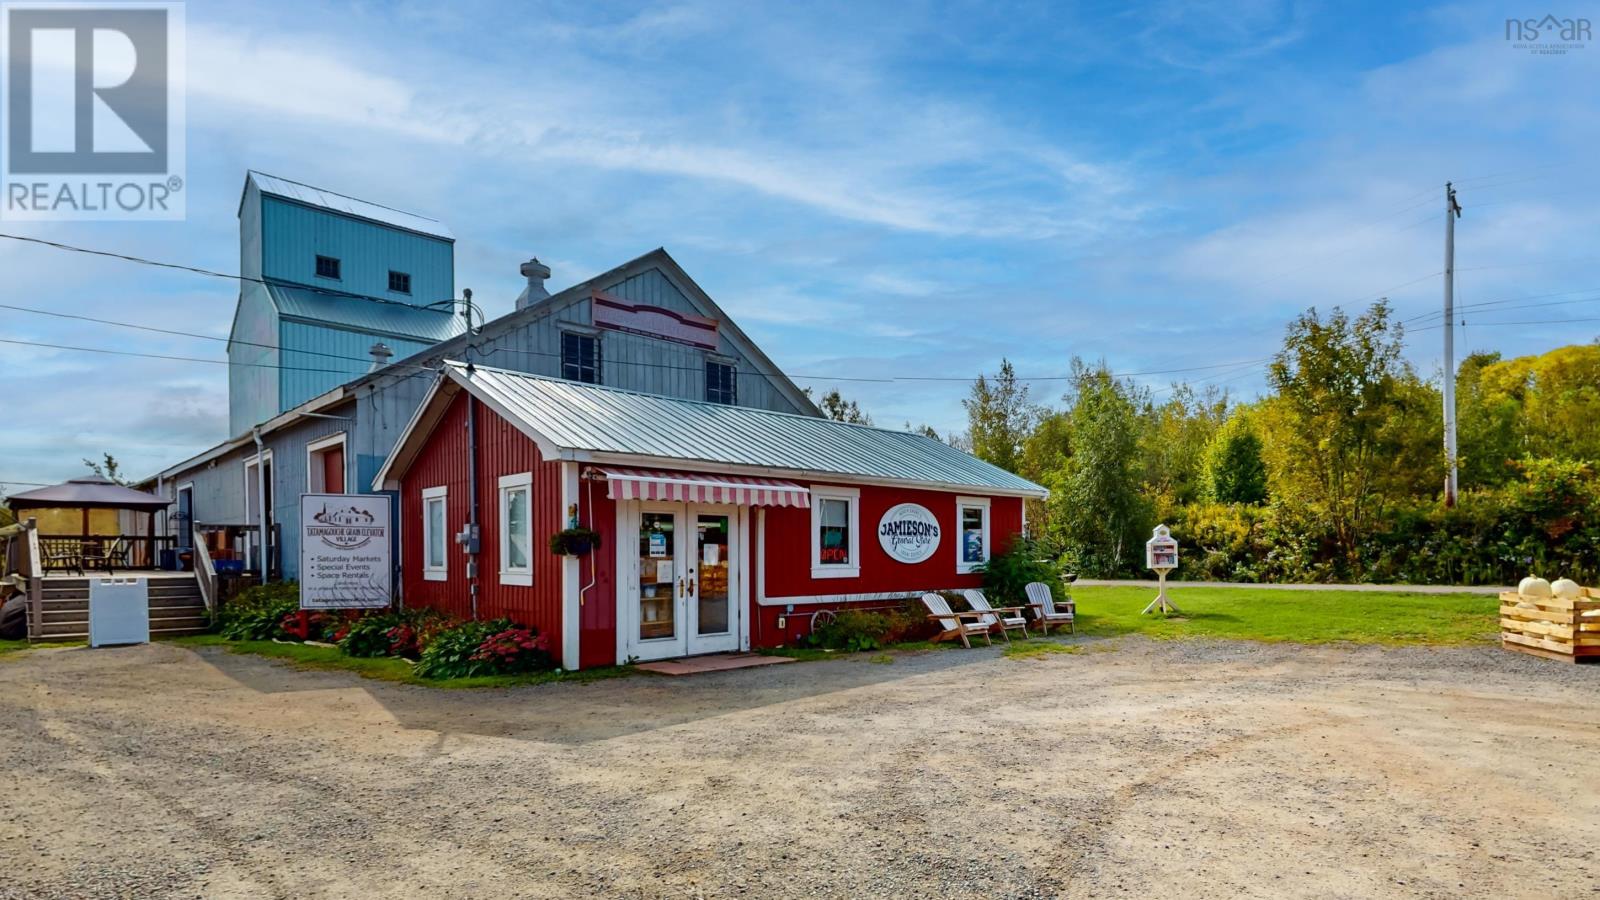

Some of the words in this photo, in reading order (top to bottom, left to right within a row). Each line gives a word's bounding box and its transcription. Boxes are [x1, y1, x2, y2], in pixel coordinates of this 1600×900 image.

[307, 528, 345, 537] TATAMAGOUCHE
[346, 528, 361, 536] GRAIN
[362, 528, 385, 537] ELEVATOR
[880, 520, 939, 538] JAMIESON'S
[891, 535, 914, 552] General
[317, 555, 350, 563] Saturday
[317, 563, 344, 571] Special
[317, 572, 340, 580] Space
[342, 571, 370, 579] Rentals
